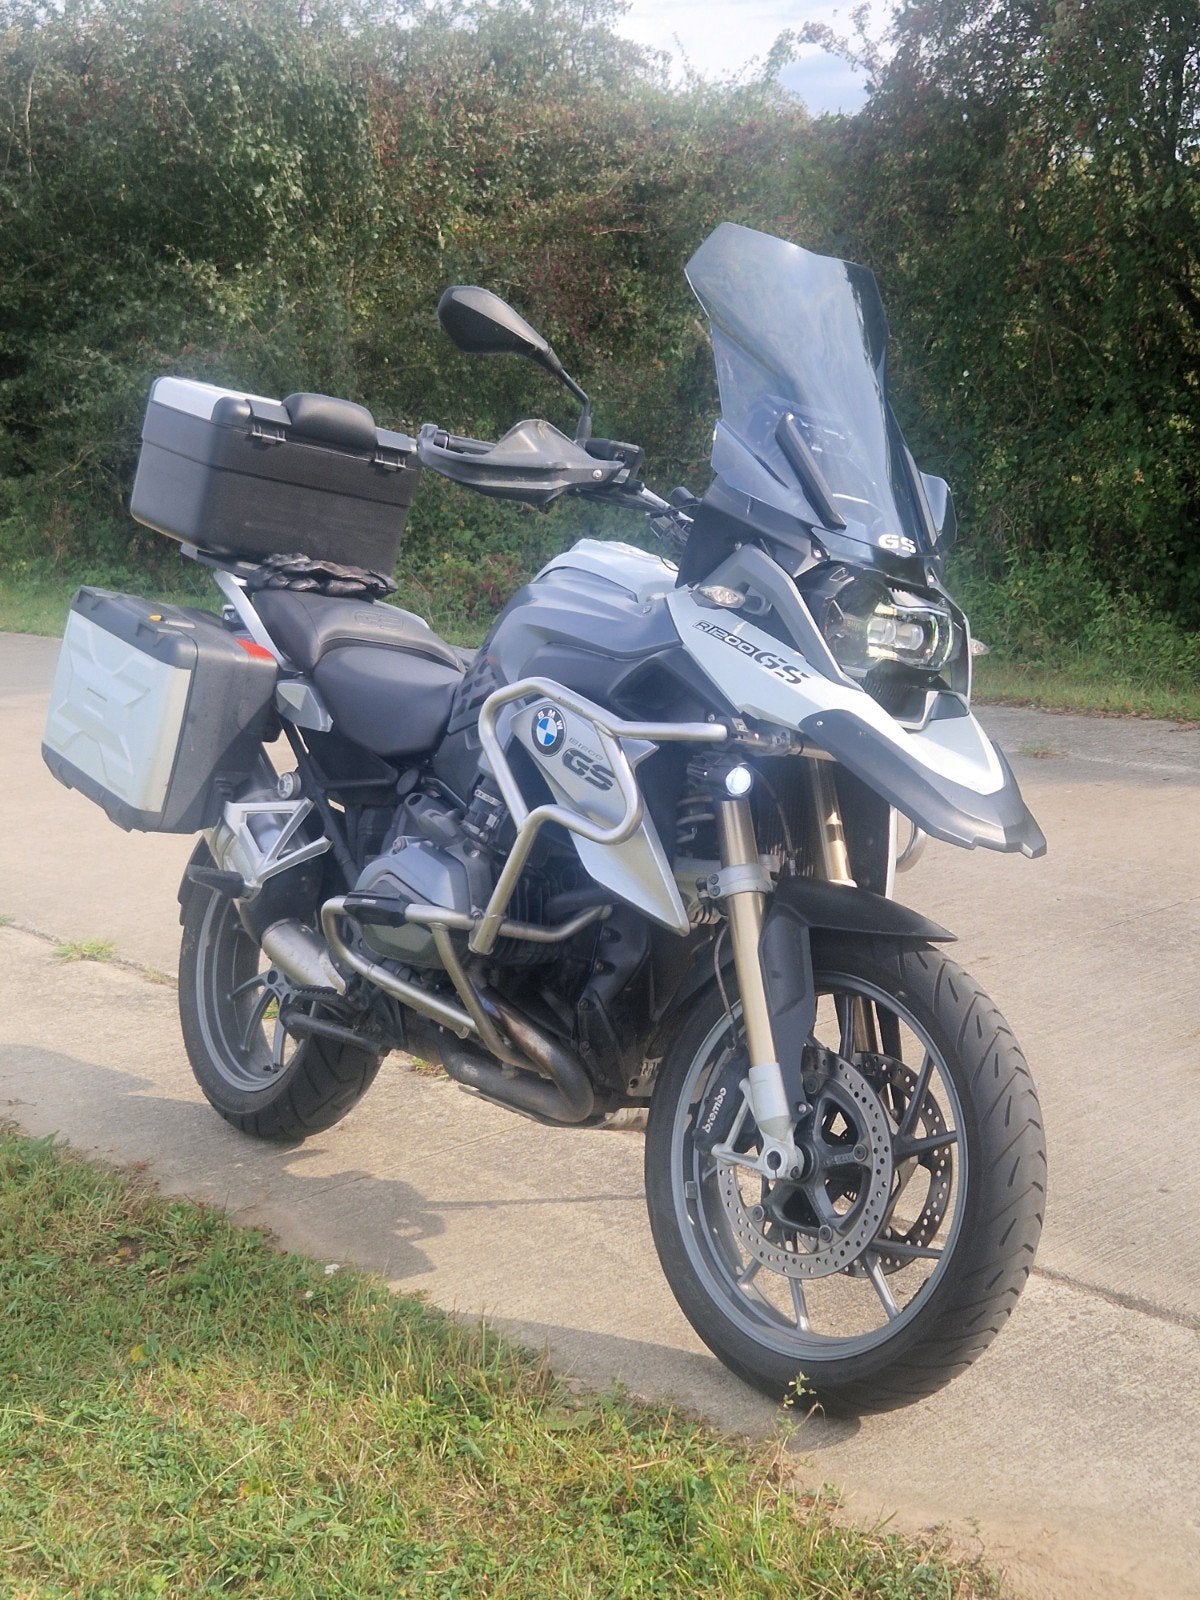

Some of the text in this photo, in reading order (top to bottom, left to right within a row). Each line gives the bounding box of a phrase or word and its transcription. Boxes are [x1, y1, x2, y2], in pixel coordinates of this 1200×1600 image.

[878, 534, 916, 554] GS
[537, 709, 564, 730] BMW
[562, 748, 616, 791] GS
[702, 1087, 727, 1134] brembo
